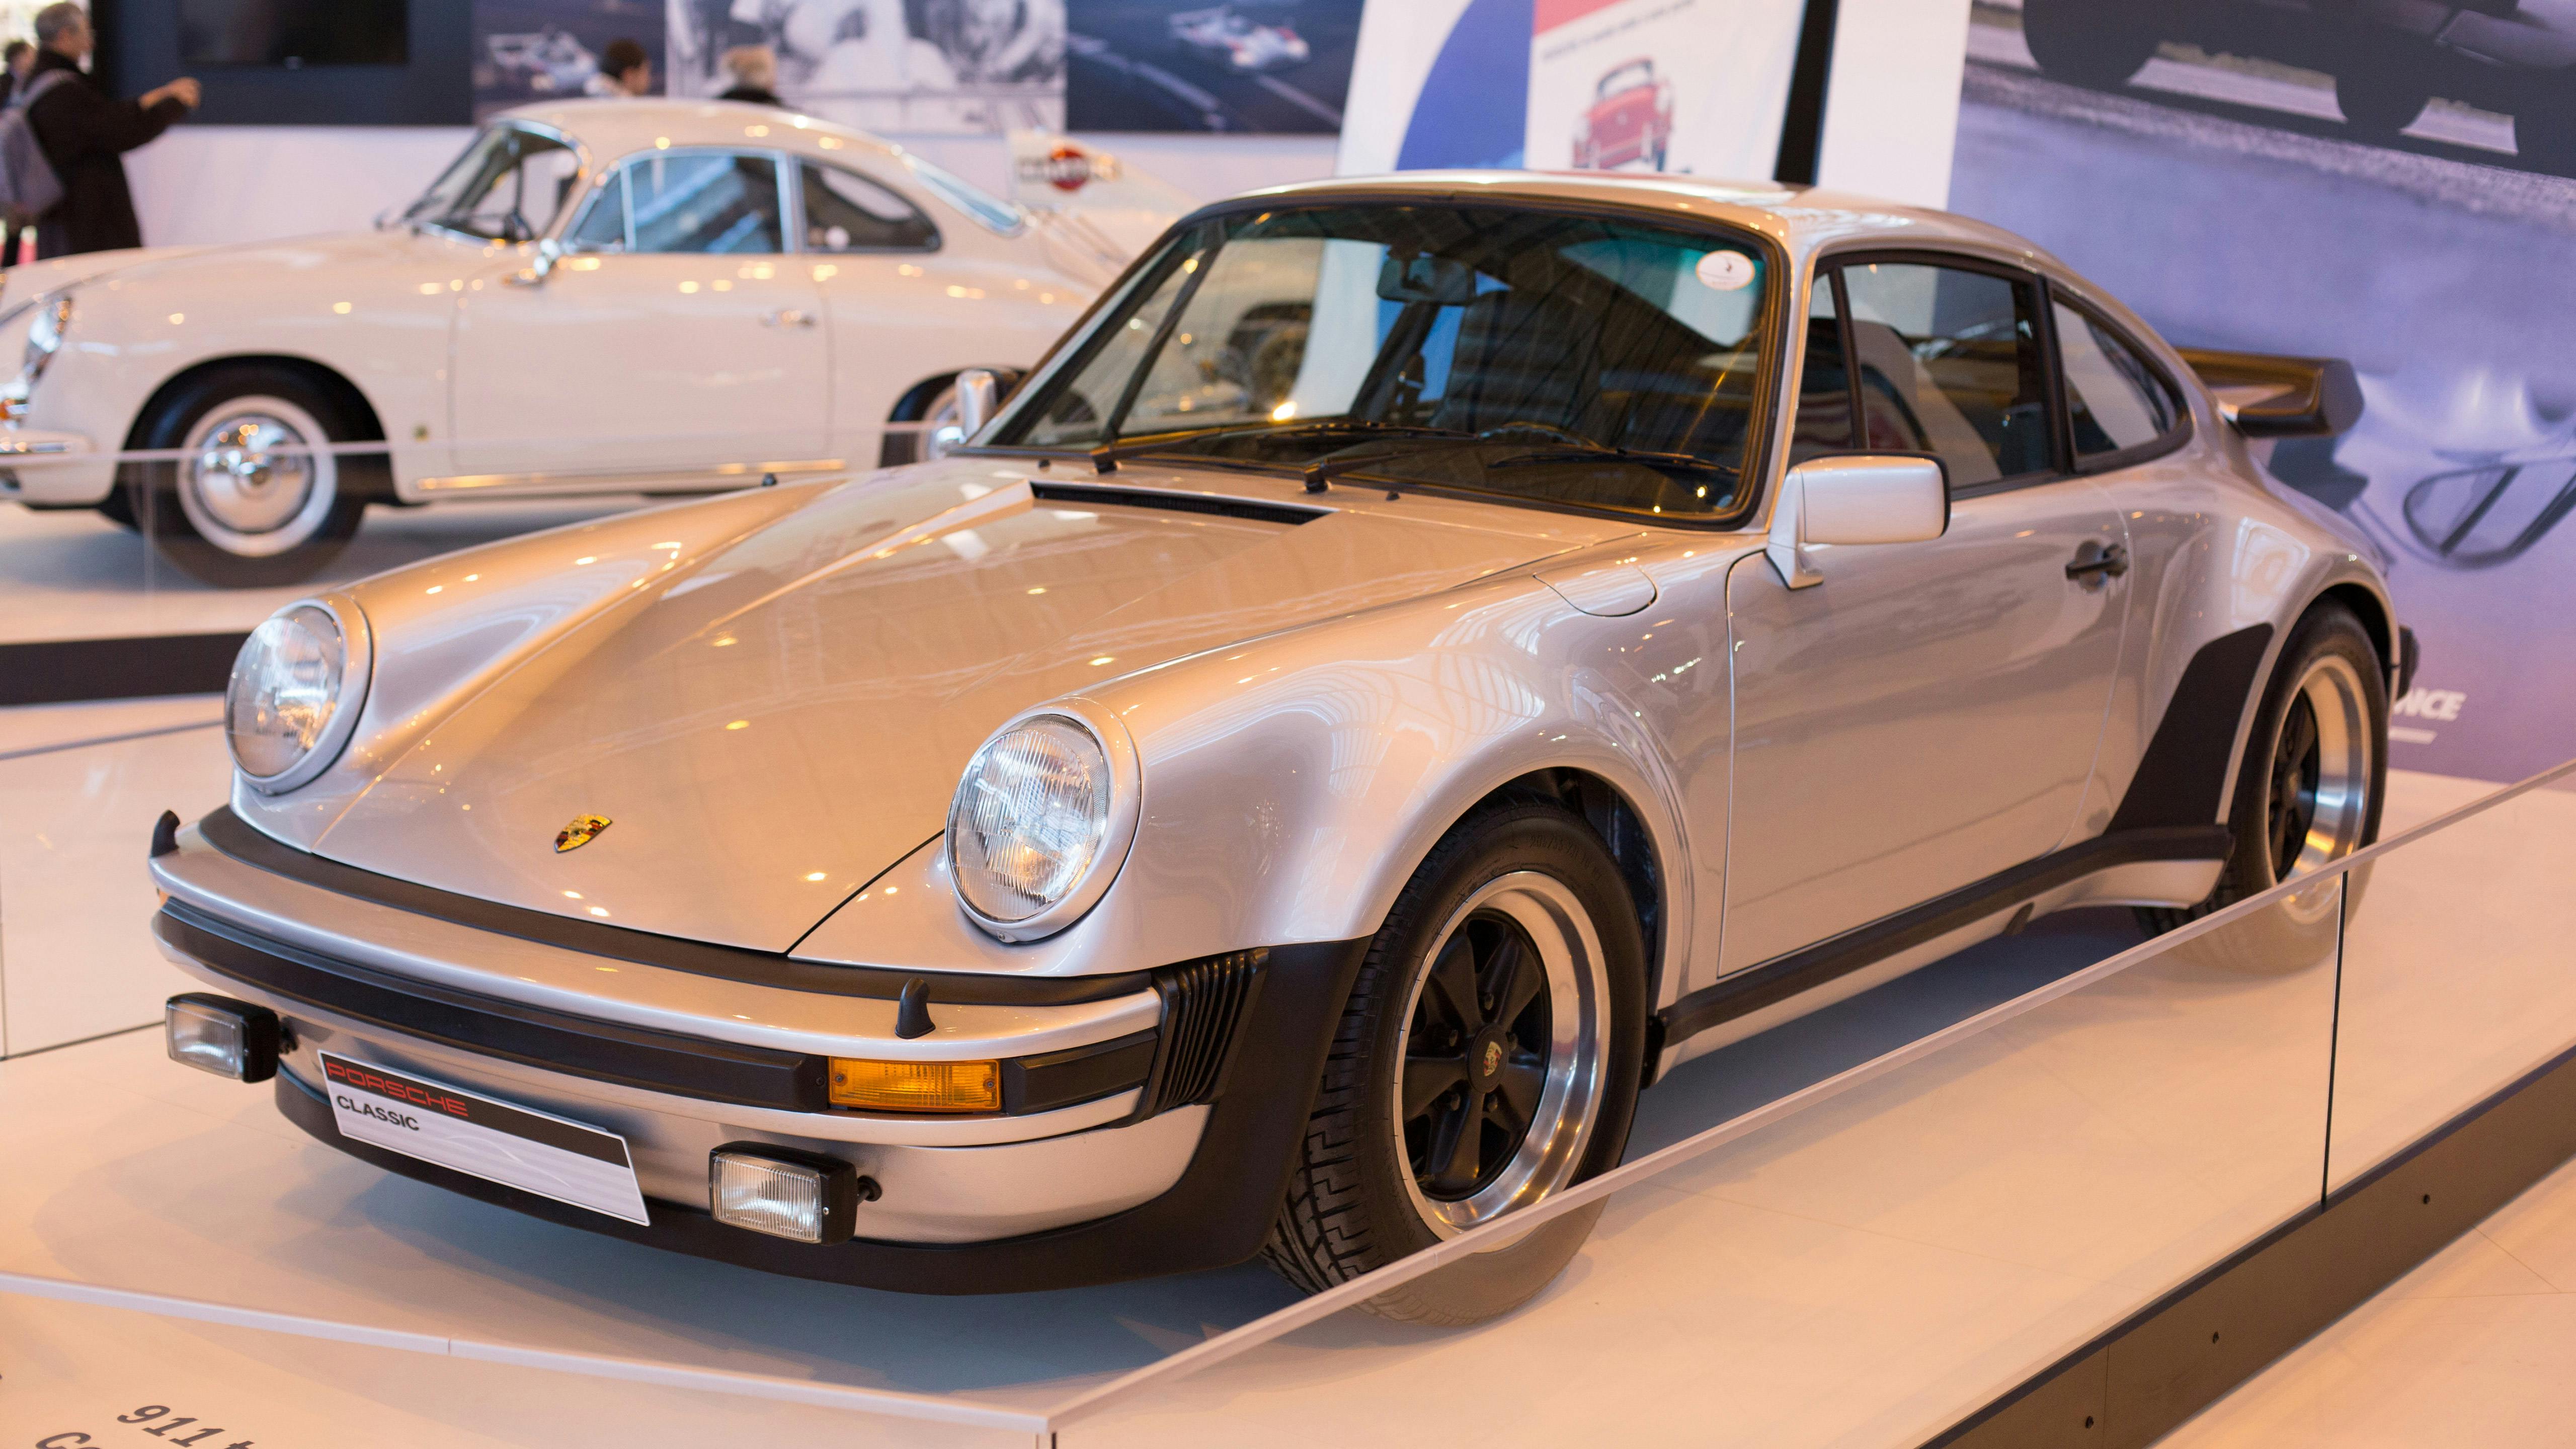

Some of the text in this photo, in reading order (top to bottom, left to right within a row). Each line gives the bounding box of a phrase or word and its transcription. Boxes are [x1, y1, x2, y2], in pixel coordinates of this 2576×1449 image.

[326, 1062, 468, 1117] PORSCHE
[337, 1095, 419, 1131] CLASSIC
[117, 1405, 225, 1448] 911
